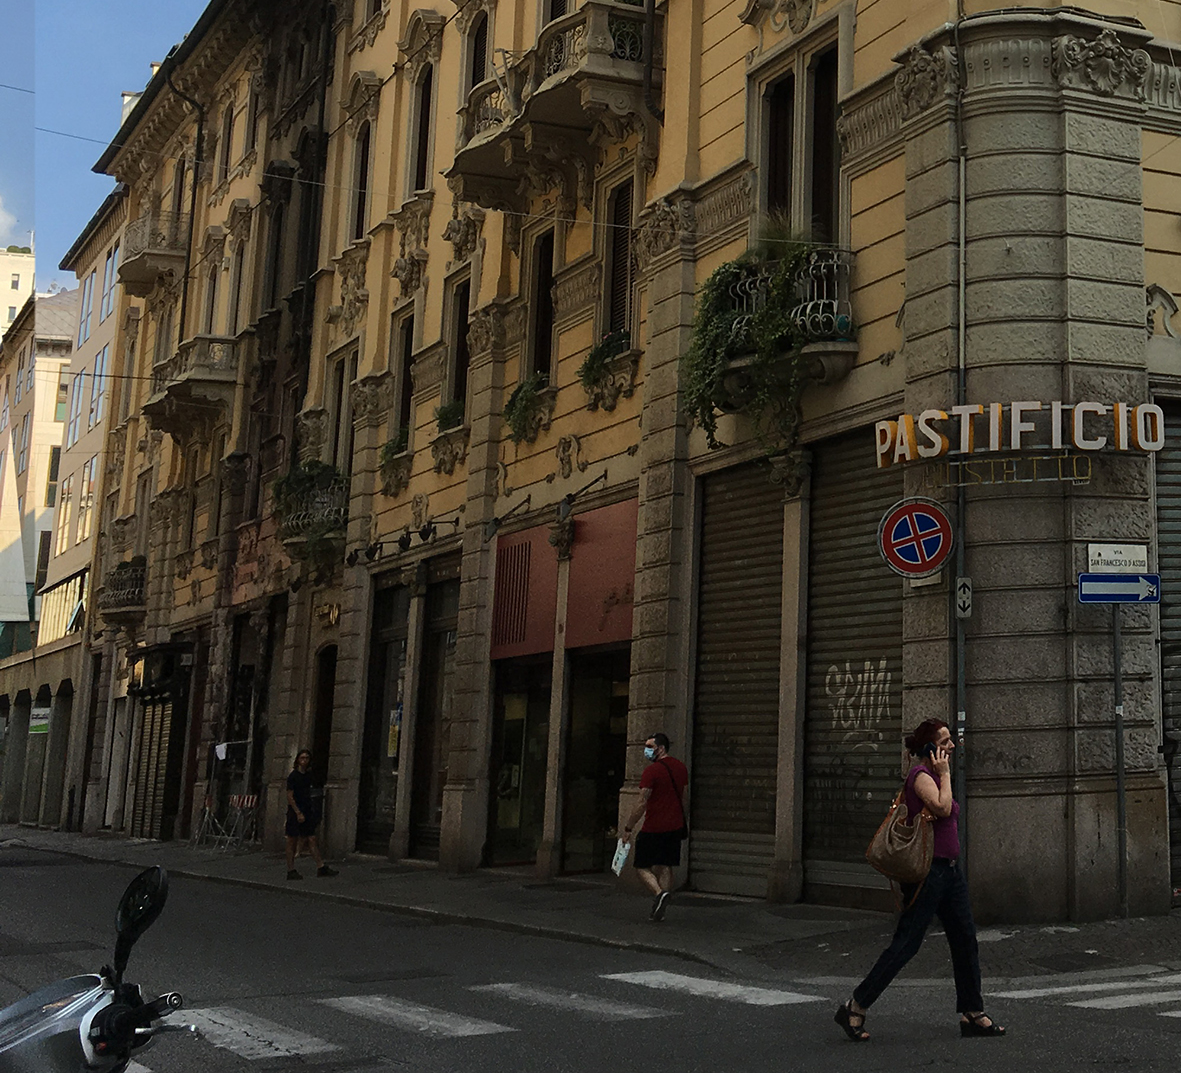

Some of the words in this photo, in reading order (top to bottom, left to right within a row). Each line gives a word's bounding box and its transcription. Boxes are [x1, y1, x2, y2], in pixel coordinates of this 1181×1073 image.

[875, 401, 1165, 468] PASTIFICIO
[1090, 559, 1100, 567] SAN
[1101, 559, 1127, 567] FRANCESCO
